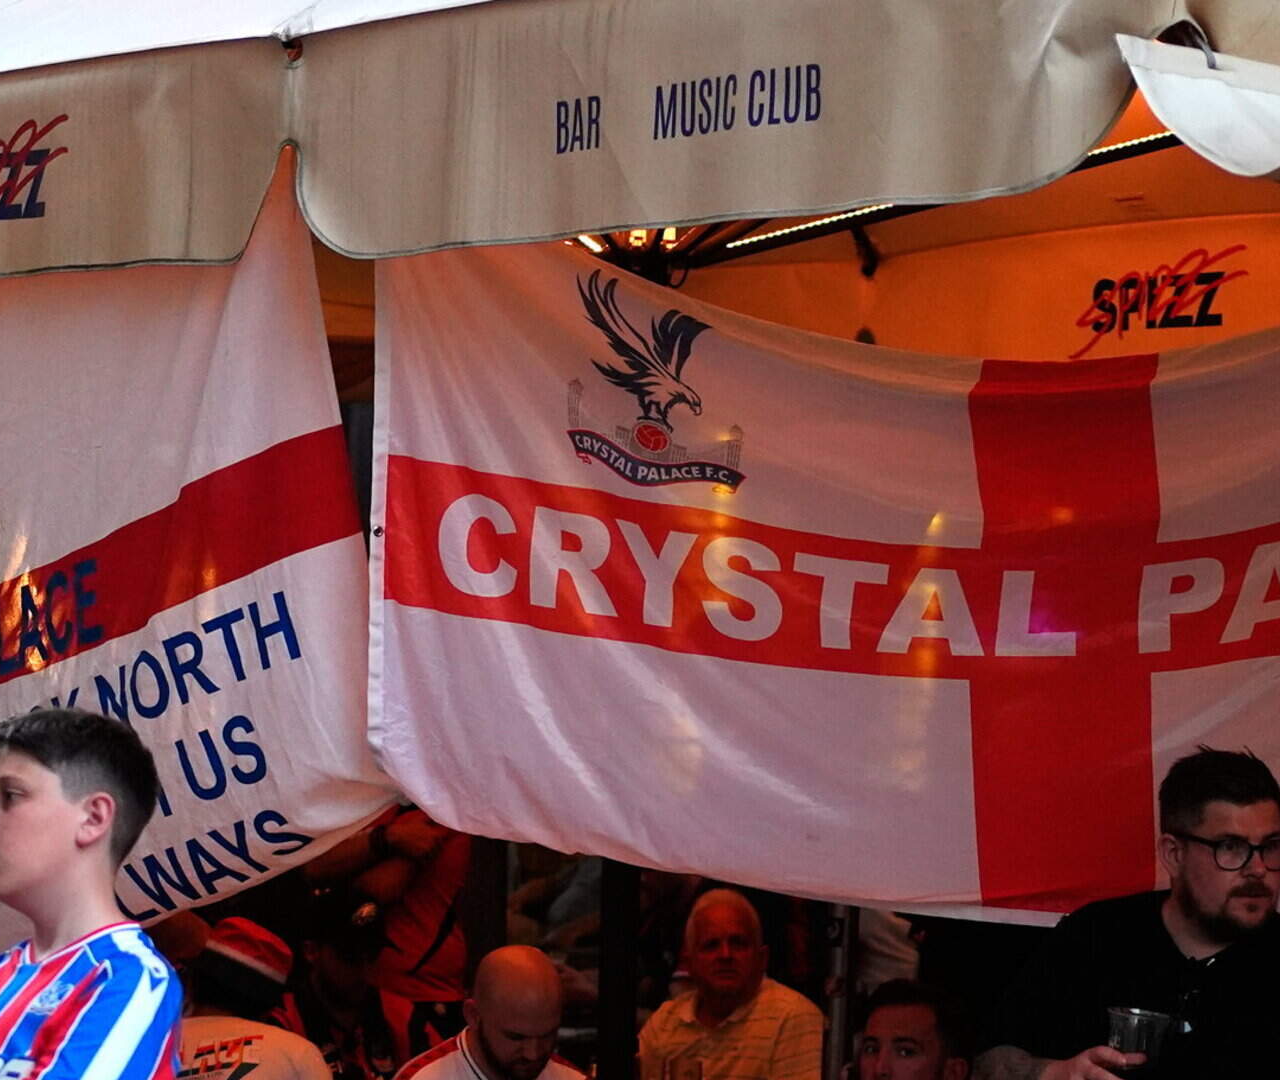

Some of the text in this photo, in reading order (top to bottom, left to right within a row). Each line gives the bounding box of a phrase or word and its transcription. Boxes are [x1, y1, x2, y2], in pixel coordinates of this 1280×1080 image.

[556, 64, 821, 154] BAR MUSIC CLUB
[574, 434, 733, 484] CRYSTAL PALACE F.C.
[437, 493, 1077, 657] CRYSTAL
[93, 590, 302, 722] NORTH
[174, 714, 268, 801] US
[114, 808, 316, 923] LWAYS
